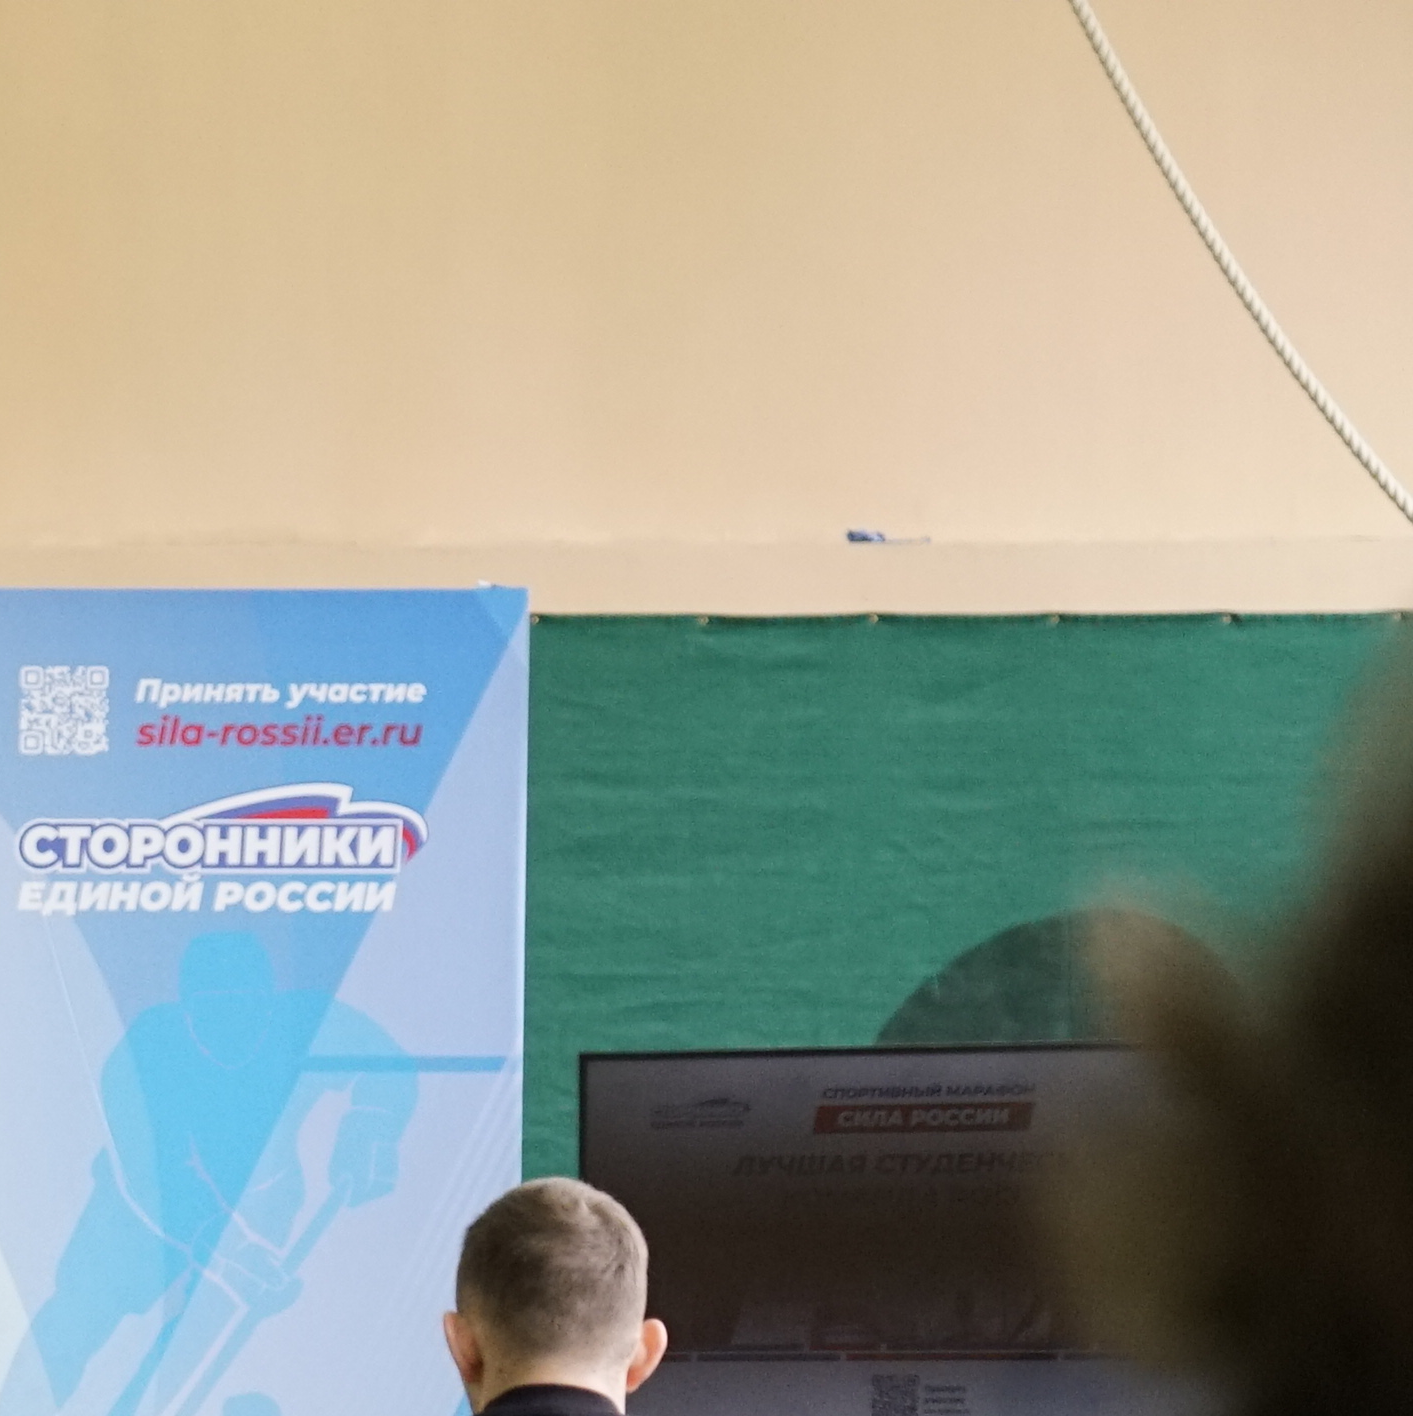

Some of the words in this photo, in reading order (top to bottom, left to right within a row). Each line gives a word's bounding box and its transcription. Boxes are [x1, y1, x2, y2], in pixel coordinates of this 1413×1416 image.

[134, 677, 280, 708] Принять
[286, 681, 427, 708] участие
[135, 713, 423, 748] sila-rossii.er.ru
[19, 822, 399, 870] СТОРОННИКИ
[18, 873, 203, 915] ЕДИНОЙ
[213, 880, 397, 913] РОССИИ
[837, 1109, 904, 1128] СИЛА
[910, 1107, 1010, 1127] РОССИИ
